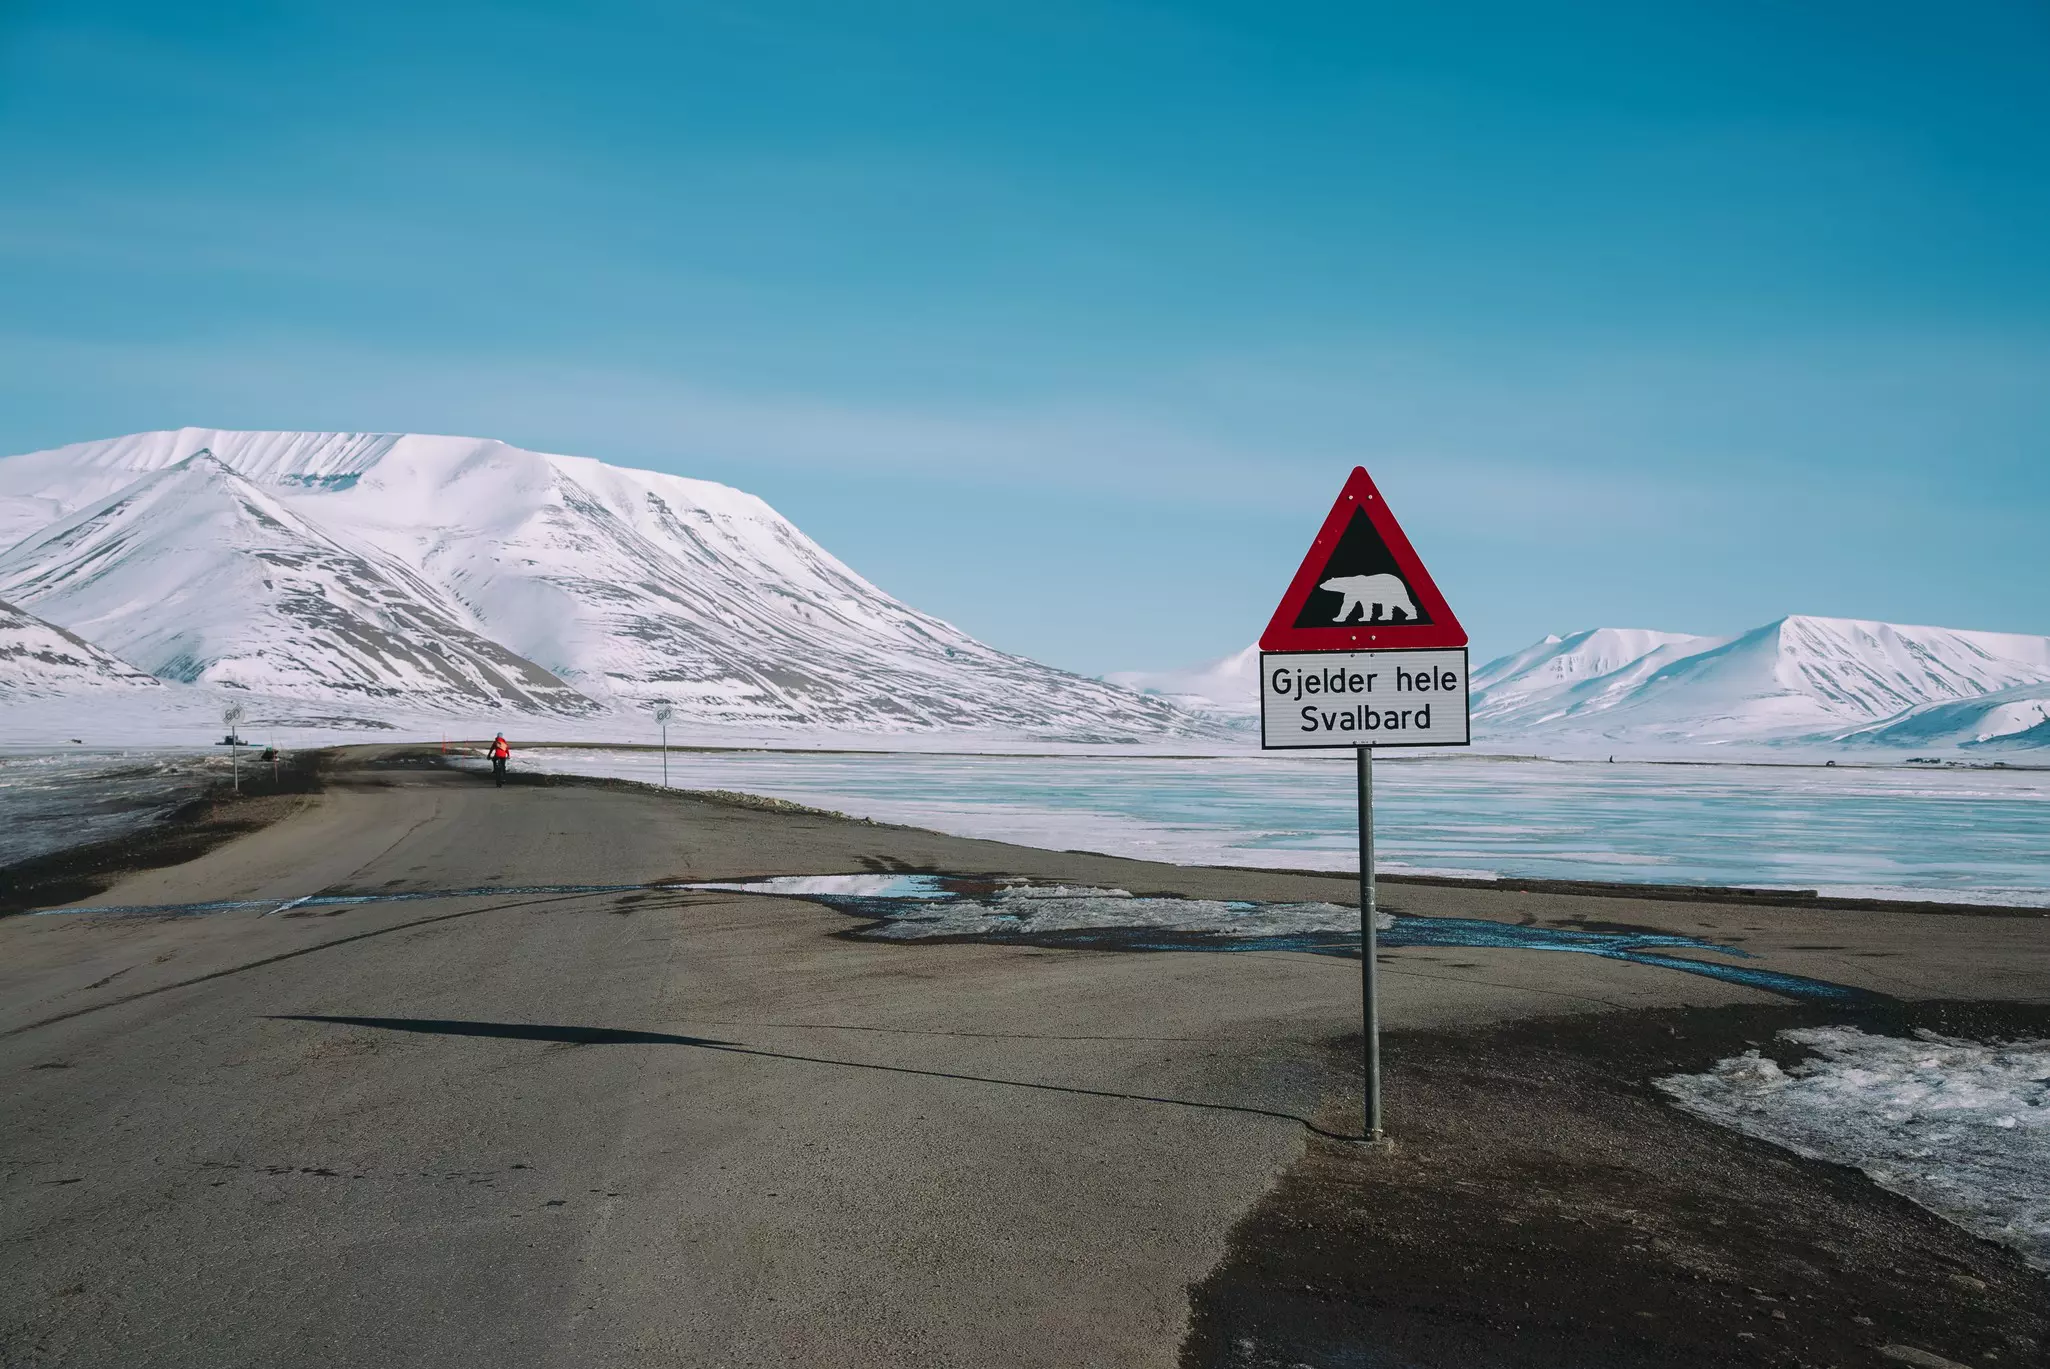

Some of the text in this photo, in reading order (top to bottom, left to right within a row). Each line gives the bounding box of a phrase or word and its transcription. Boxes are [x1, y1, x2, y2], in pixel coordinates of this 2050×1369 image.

[1272, 665, 1458, 701] Gjelder hele
[1301, 703, 1431, 732] Svalbard
